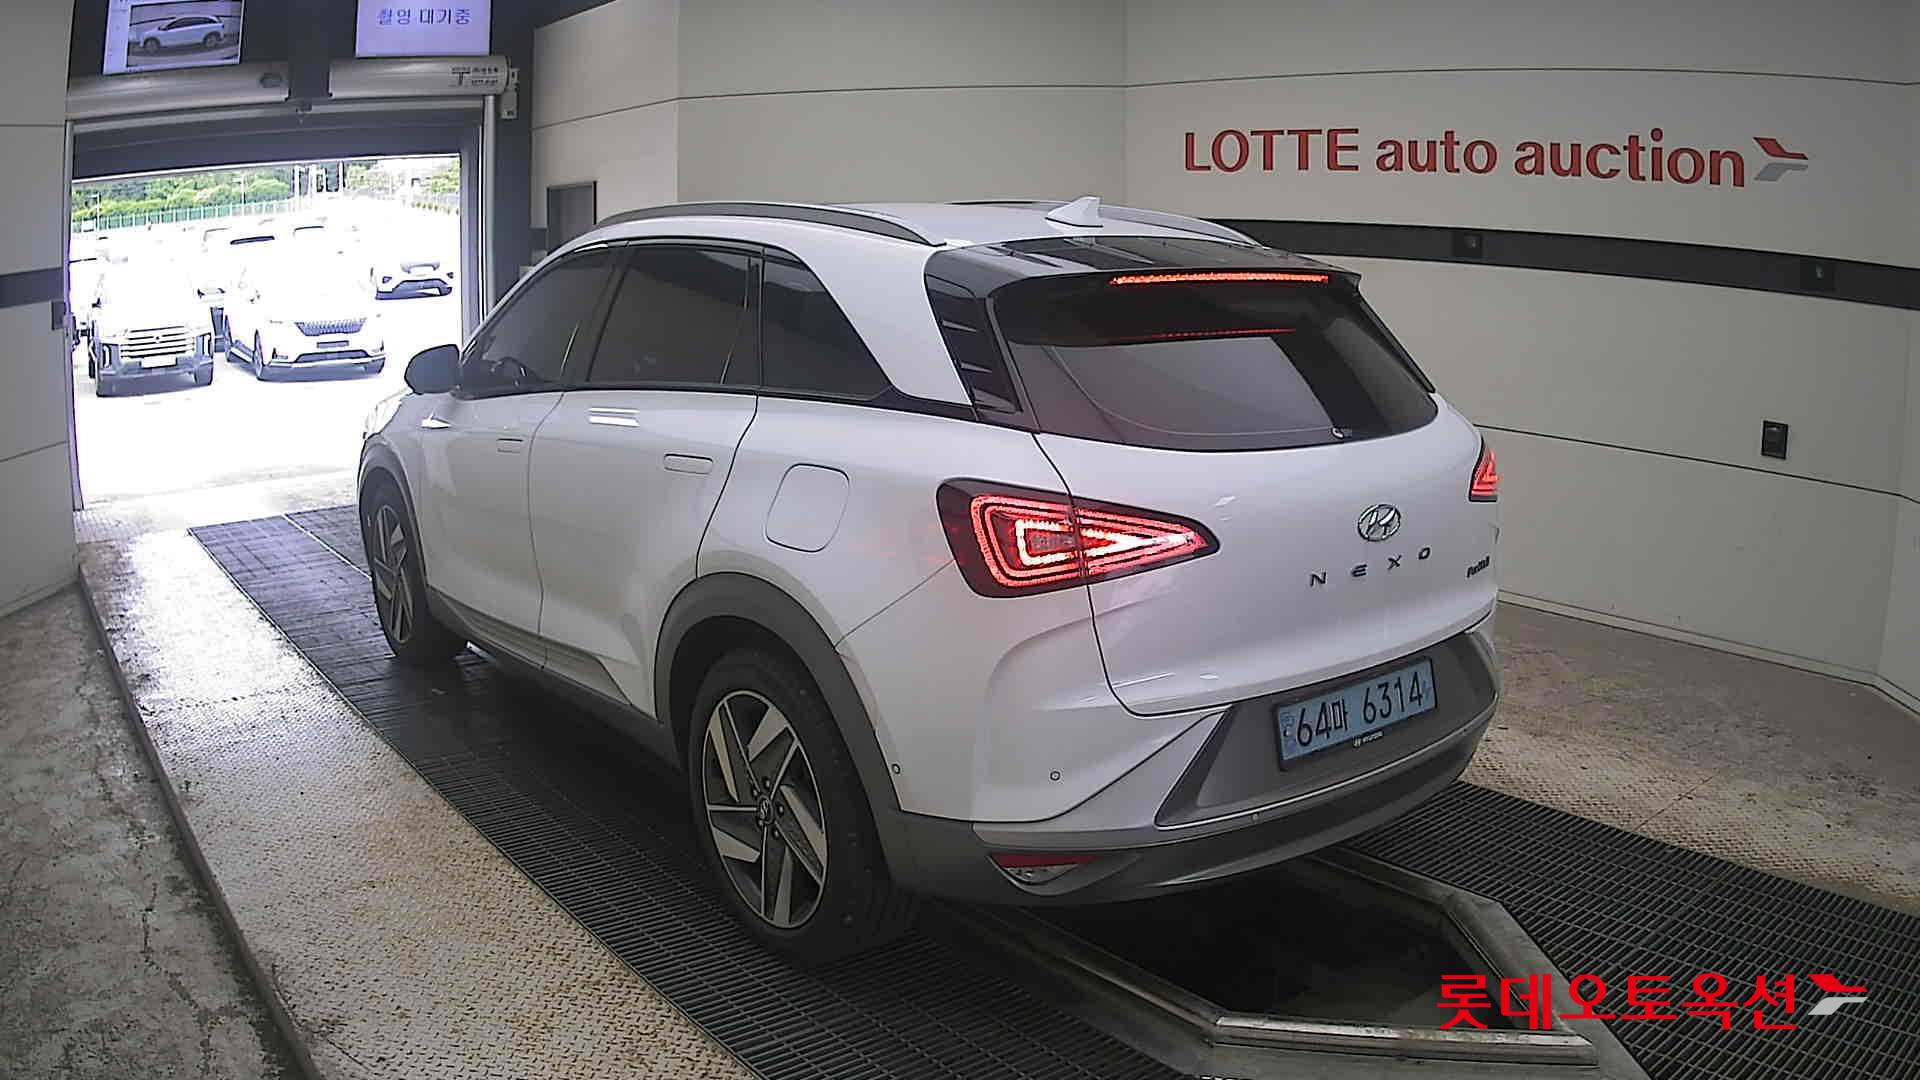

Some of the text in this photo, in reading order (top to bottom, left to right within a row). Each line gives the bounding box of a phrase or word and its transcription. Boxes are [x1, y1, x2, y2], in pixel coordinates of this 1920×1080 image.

[419, 7, 471, 25] 대기중
[1184, 127, 1746, 187] LOTTE auto auction
[1309, 546, 1431, 587] NEXO
[1296, 671, 1424, 747] 64마 6314
